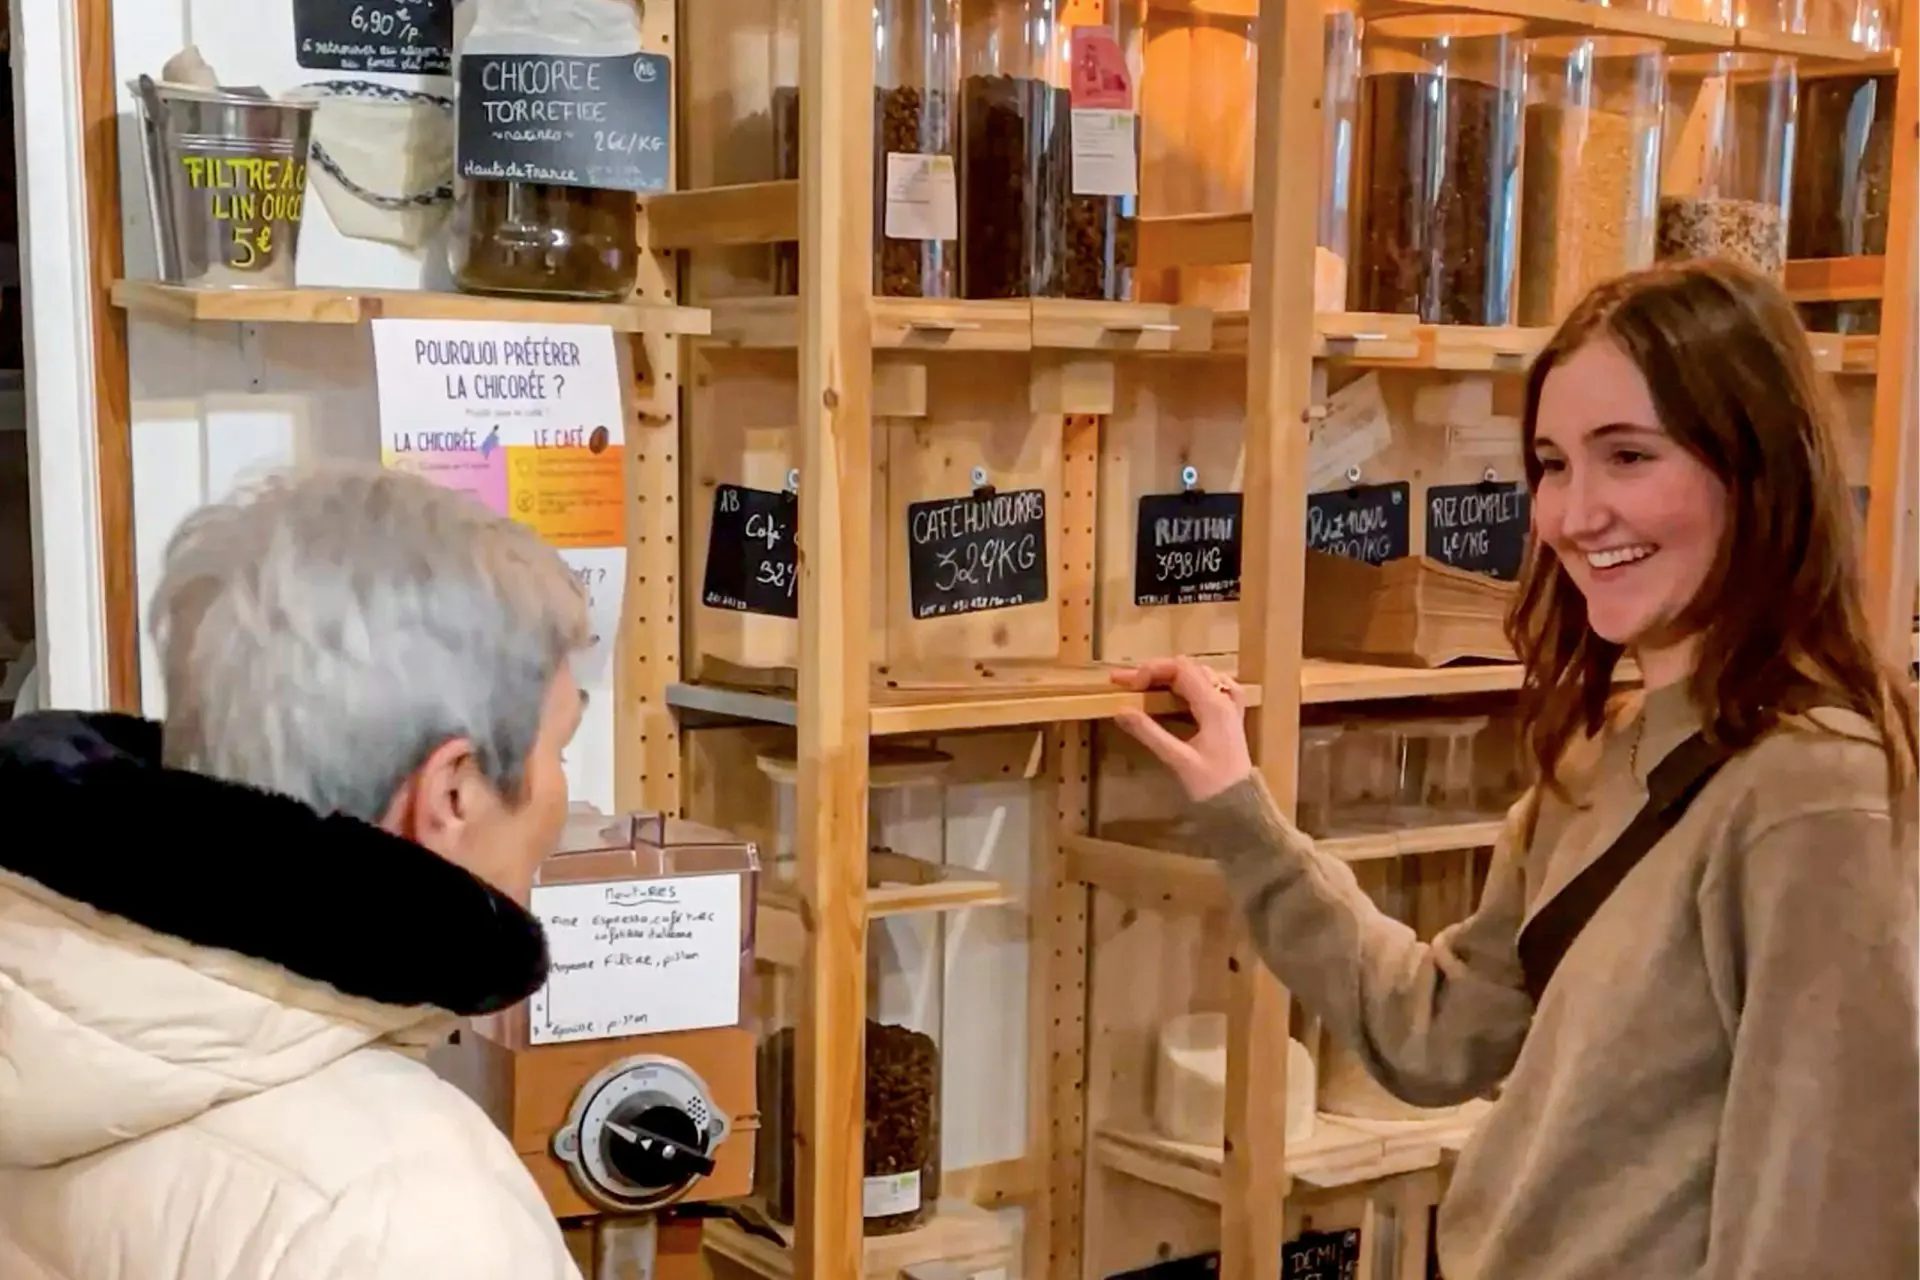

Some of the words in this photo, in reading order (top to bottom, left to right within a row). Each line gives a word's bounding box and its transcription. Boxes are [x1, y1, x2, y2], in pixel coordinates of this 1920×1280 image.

[181, 155, 279, 192] FILTRE
[213, 193, 256, 221] LIN
[415, 338, 499, 366] POURQUOI
[503, 335, 581, 367] PRÉFÉRER
[446, 375, 467, 400] LA
[474, 369, 547, 400] CHICORÉE
[552, 374, 566, 399] ?
[394, 432, 412, 453] LA
[417, 428, 478, 452] CHICORÉE
[533, 429, 548, 449] LE
[555, 425, 586, 450] CAFÉ
[1431, 496, 1457, 529] RIZ
[1460, 490, 1527, 527] COMPLET
